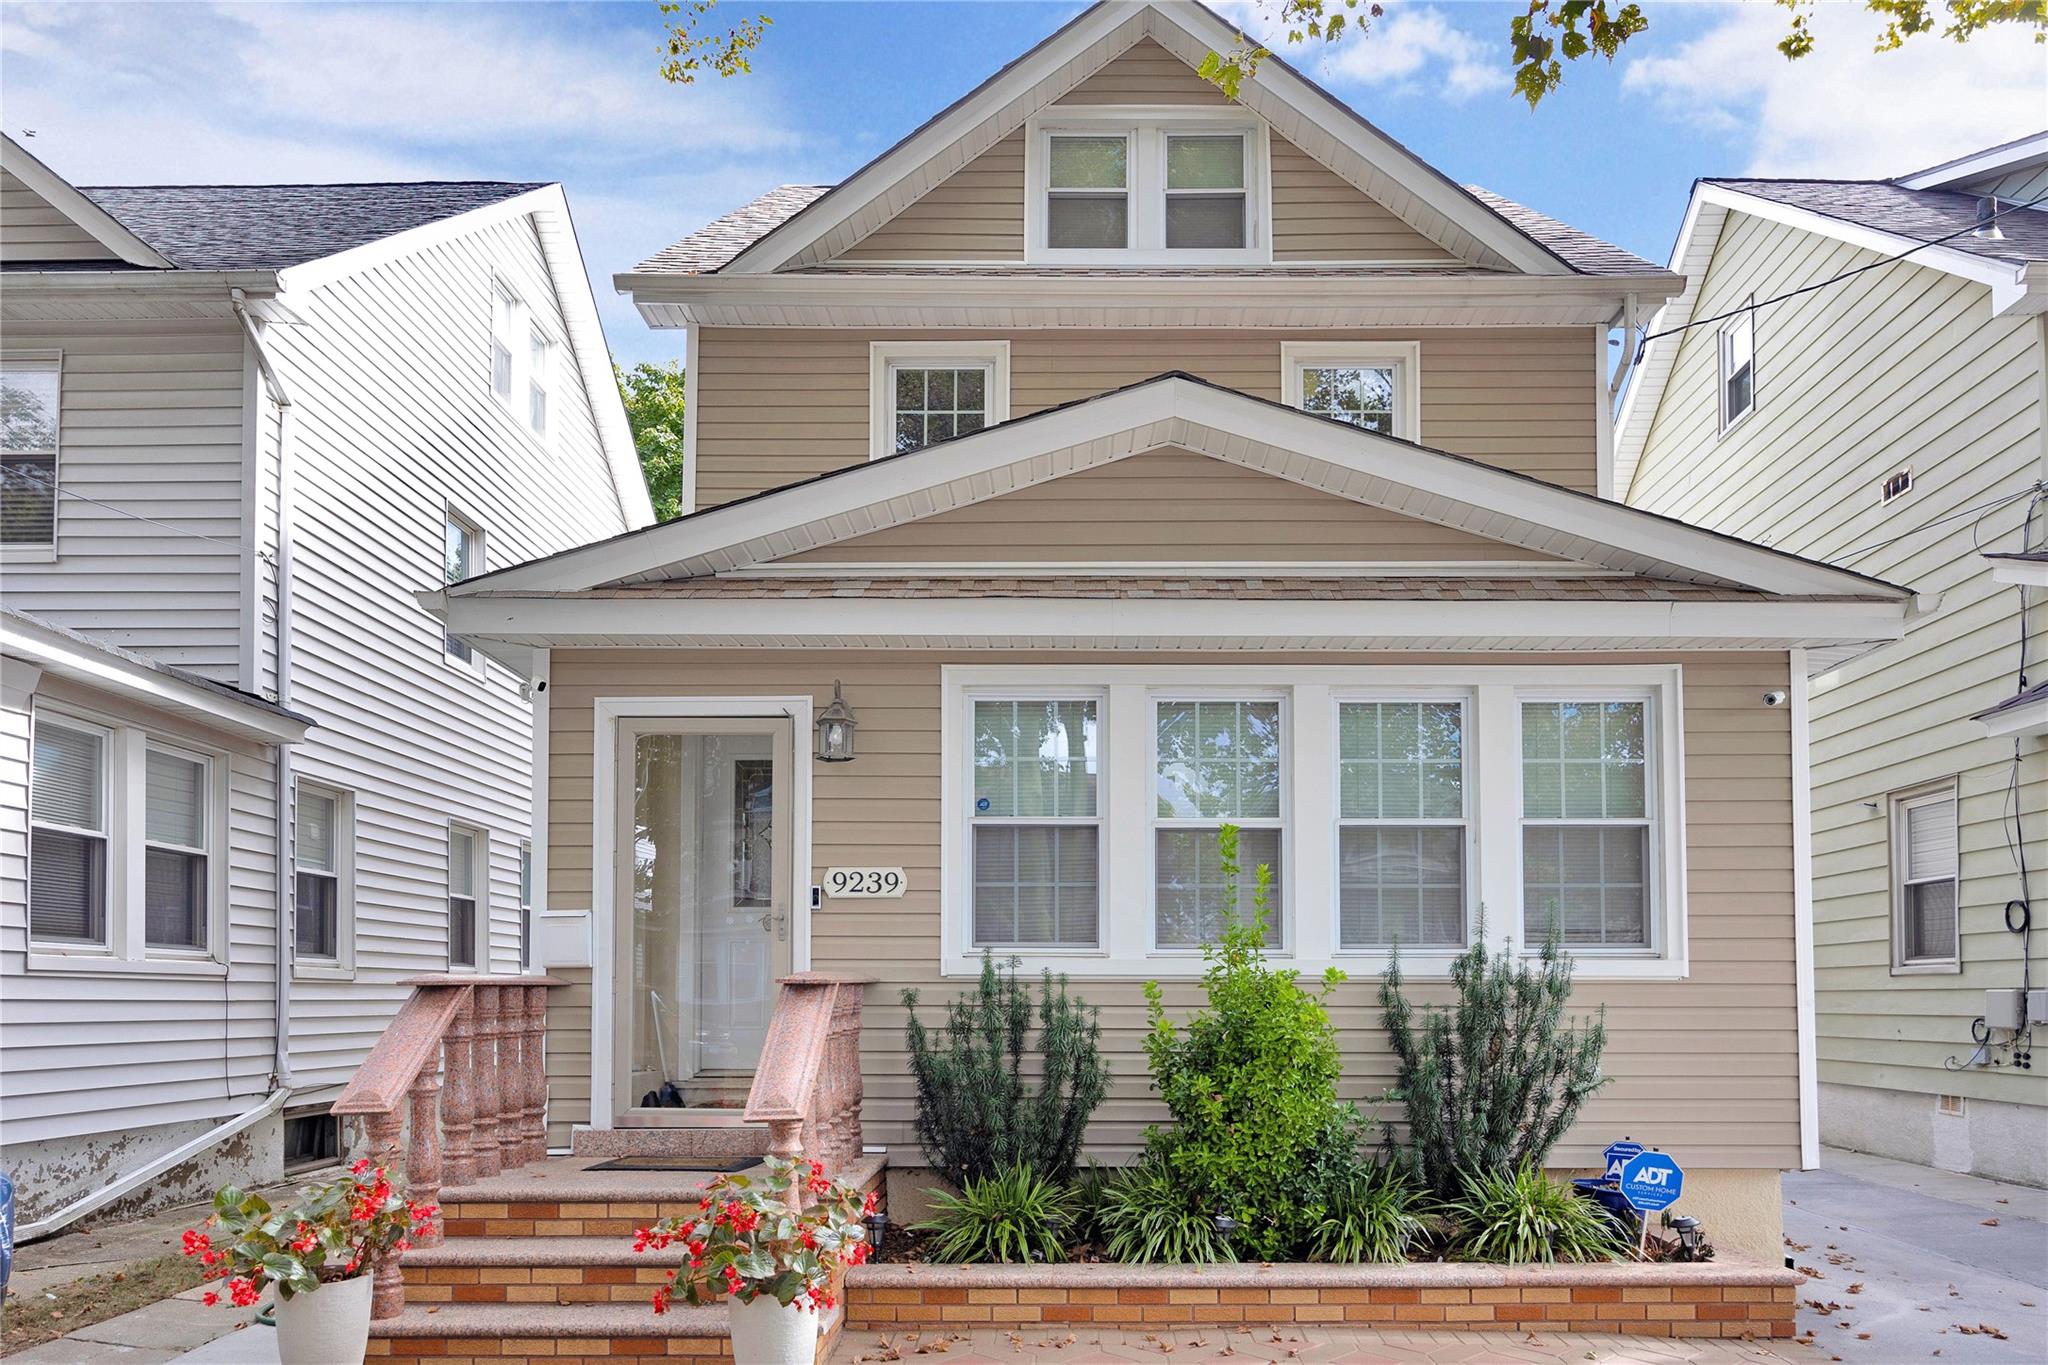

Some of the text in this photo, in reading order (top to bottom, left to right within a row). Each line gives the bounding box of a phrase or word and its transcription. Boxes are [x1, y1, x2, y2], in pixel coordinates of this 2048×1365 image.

[832, 871, 899, 894] 9239
[1633, 1166, 1673, 1186] ADT
[1625, 1183, 1676, 1195] CUSTOM HOME
